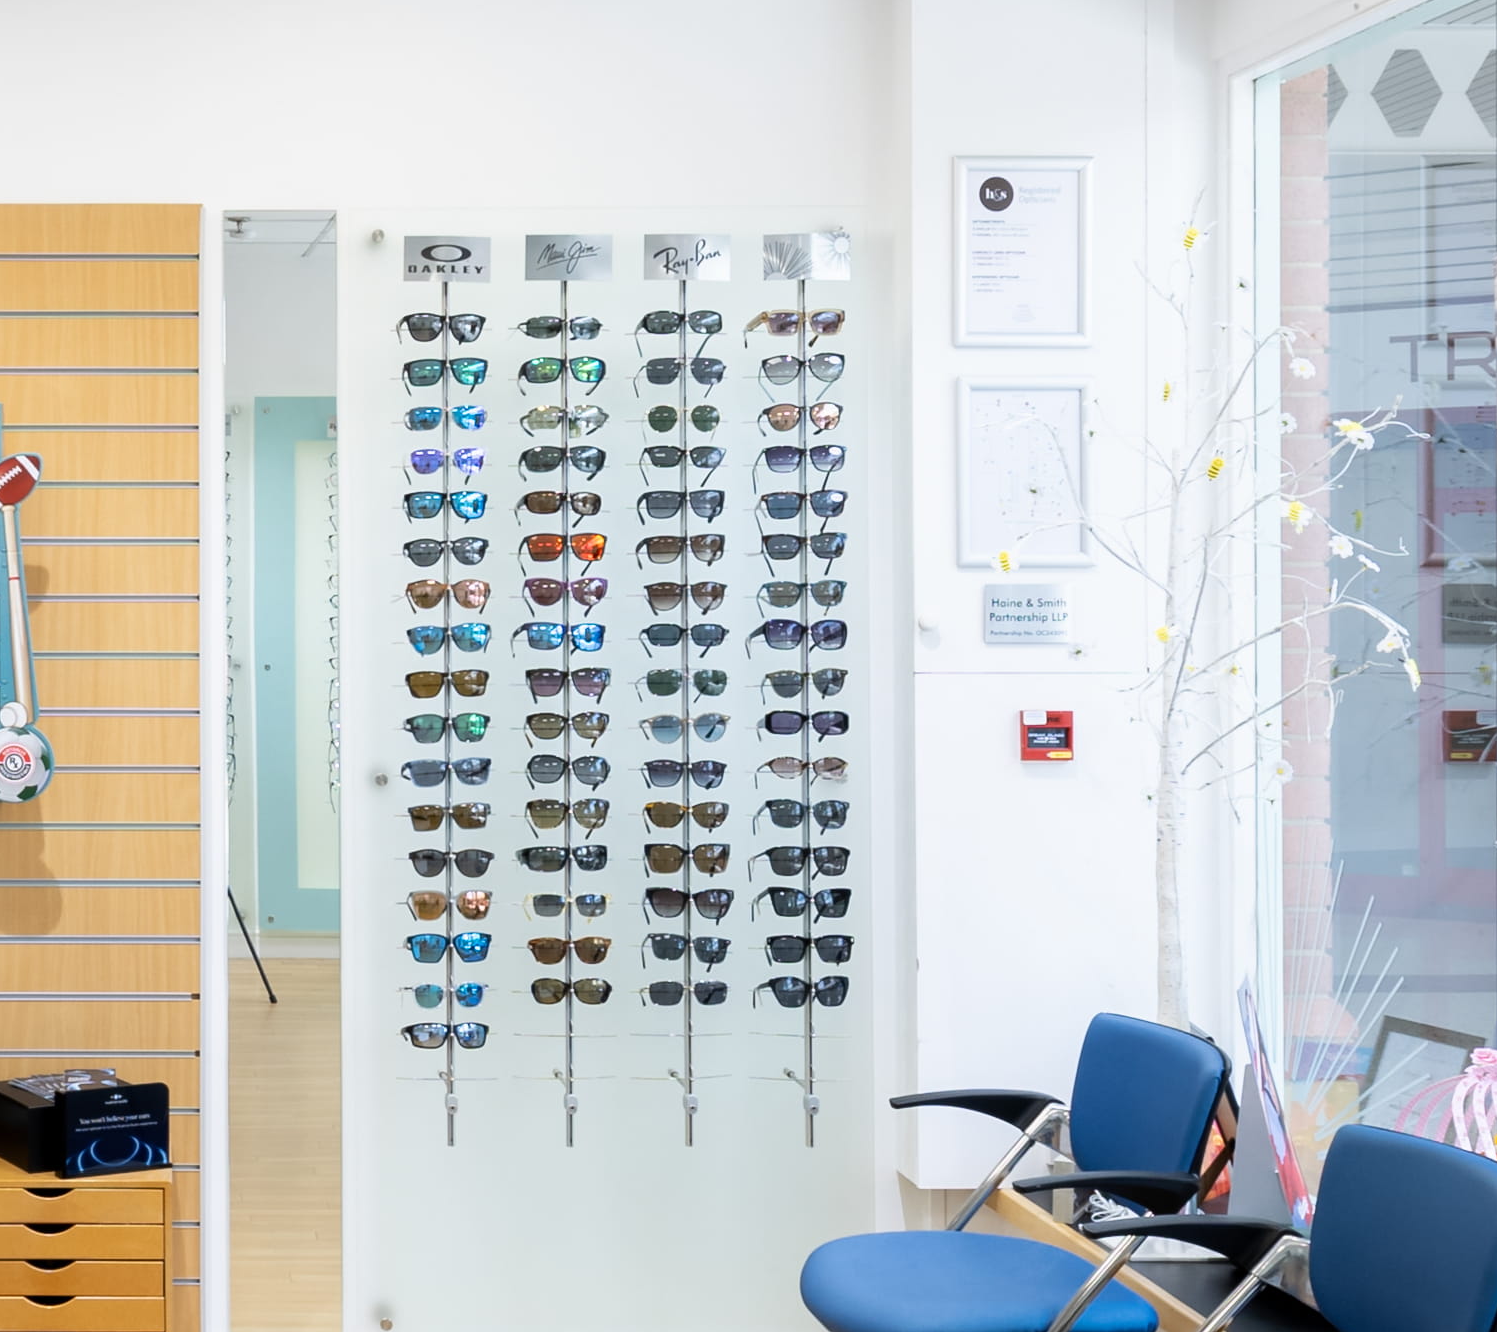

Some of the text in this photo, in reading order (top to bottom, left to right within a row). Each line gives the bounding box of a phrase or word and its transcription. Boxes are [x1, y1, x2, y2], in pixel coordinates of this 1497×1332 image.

[986, 188, 1007, 201] h&s
[408, 265, 483, 274] OAKLEY
[992, 597, 1068, 608] Haine & Smith
[989, 612, 1068, 624] Partnership LLP
